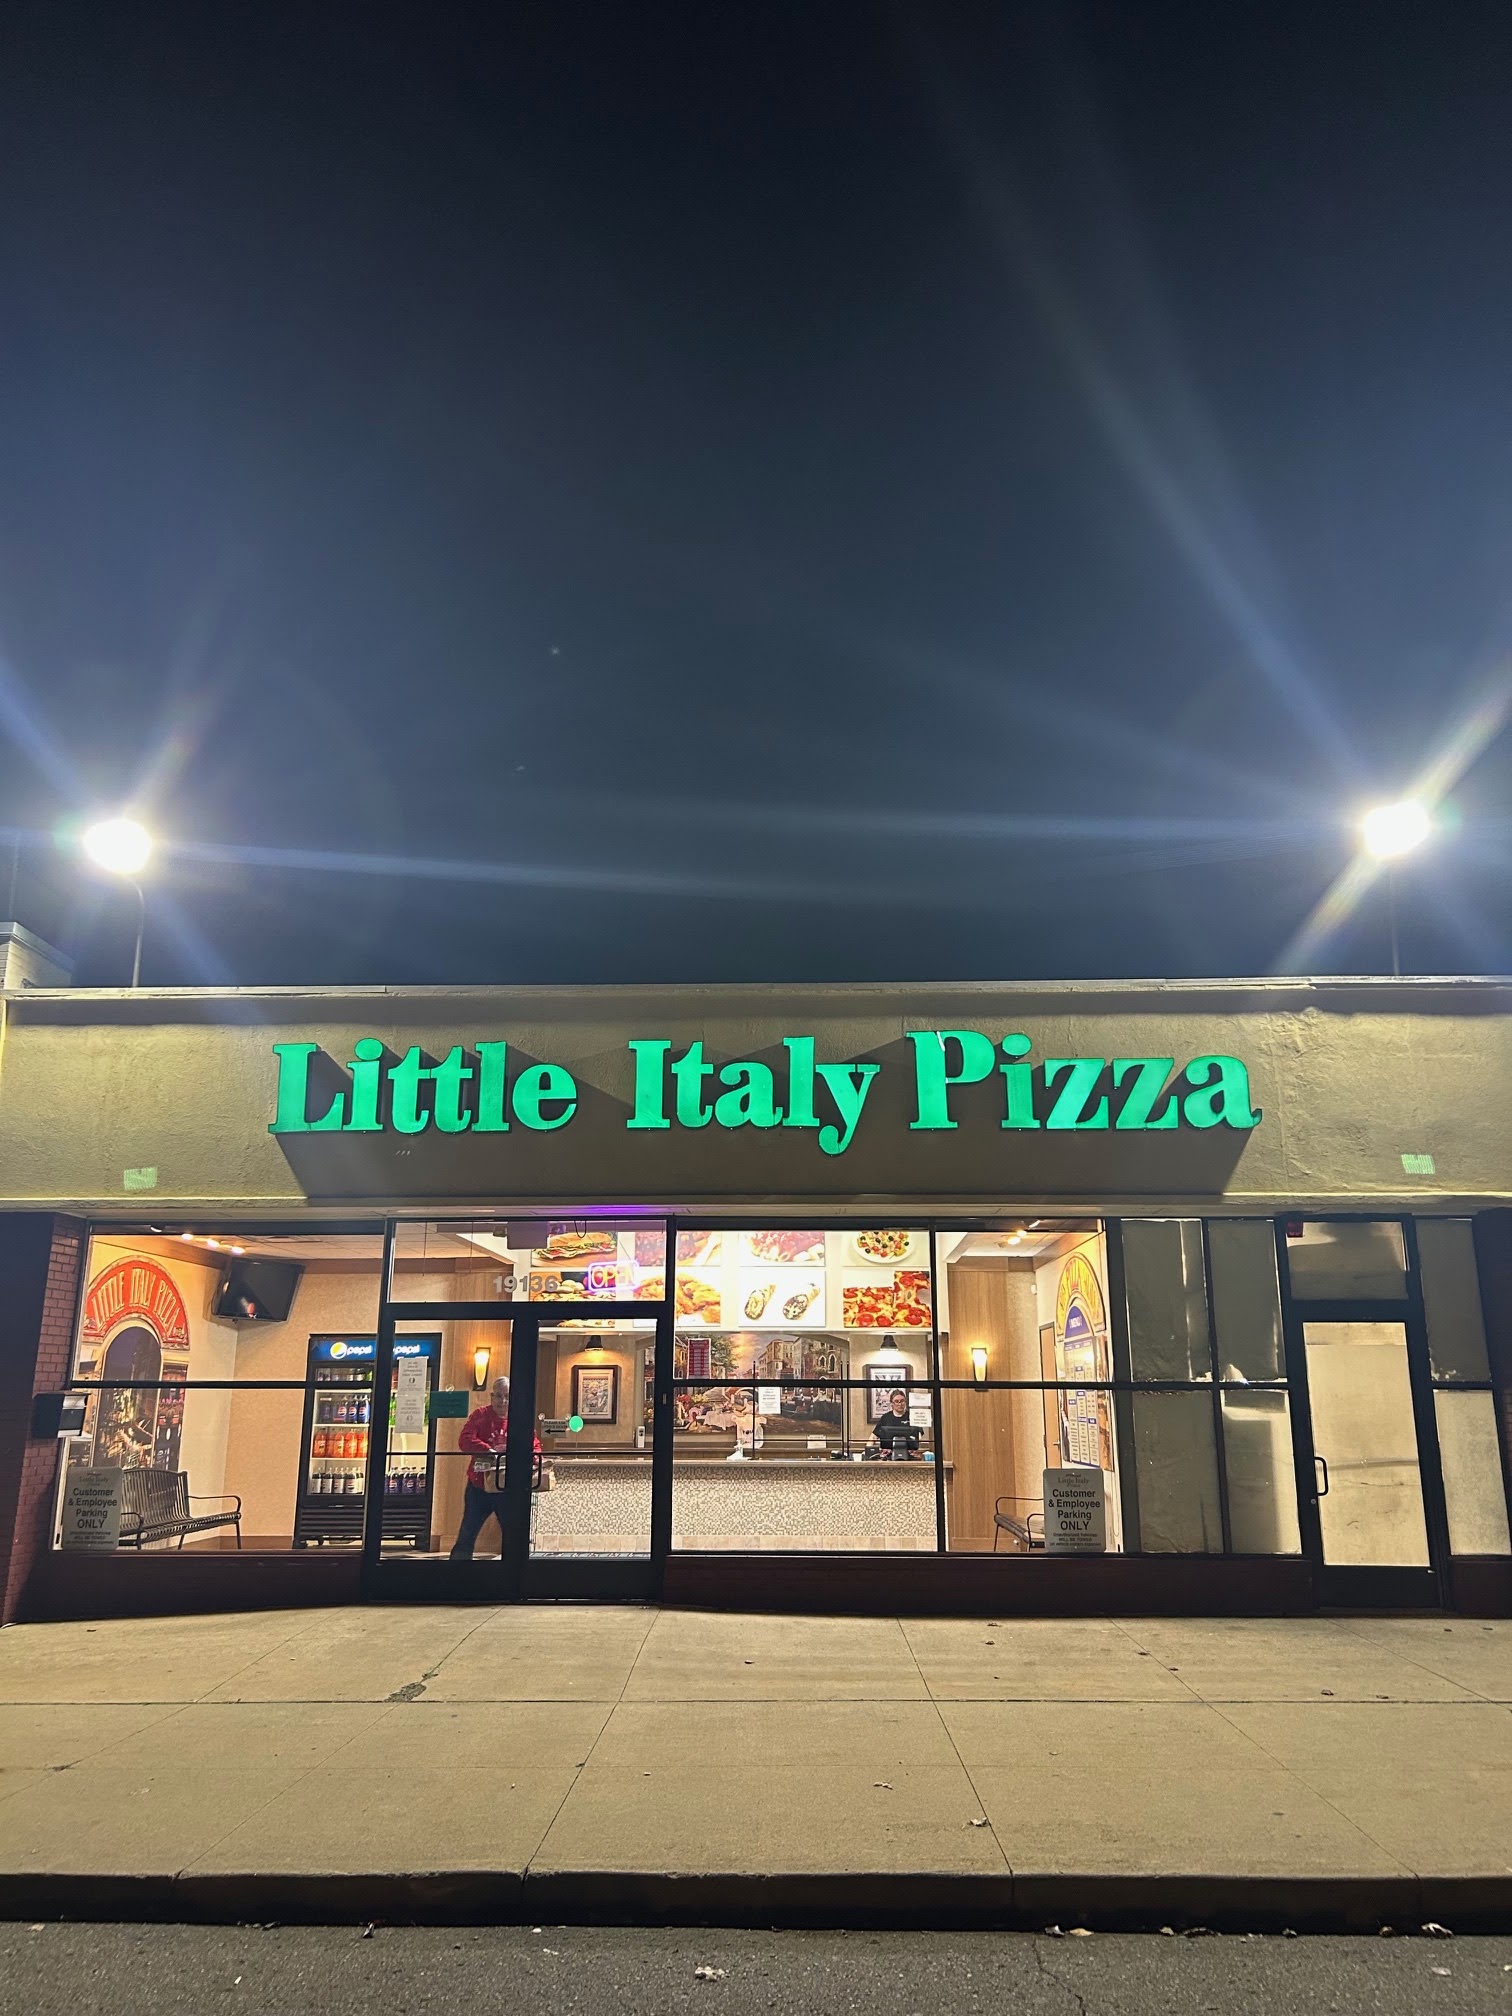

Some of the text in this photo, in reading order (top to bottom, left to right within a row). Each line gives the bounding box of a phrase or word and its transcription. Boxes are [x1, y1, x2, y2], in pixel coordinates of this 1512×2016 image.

[268, 1030, 1261, 1154] Little Italy Pizza
[592, 1263, 635, 1287] OPEN
[493, 1275, 558, 1294] 19136
[91, 1268, 180, 1338] LITTLE ITALY PIZZA
[73, 1487, 114, 1496] Customer
[1052, 1489, 1095, 1498] Customer
[68, 1498, 117, 1507] & Employee
[1048, 1499, 1100, 1509] & Employee
[76, 1508, 108, 1518] Parking
[1058, 1510, 1092, 1520] Parking
[77, 1519, 106, 1529] ONLY
[1060, 1520, 1089, 1530] ONLY
